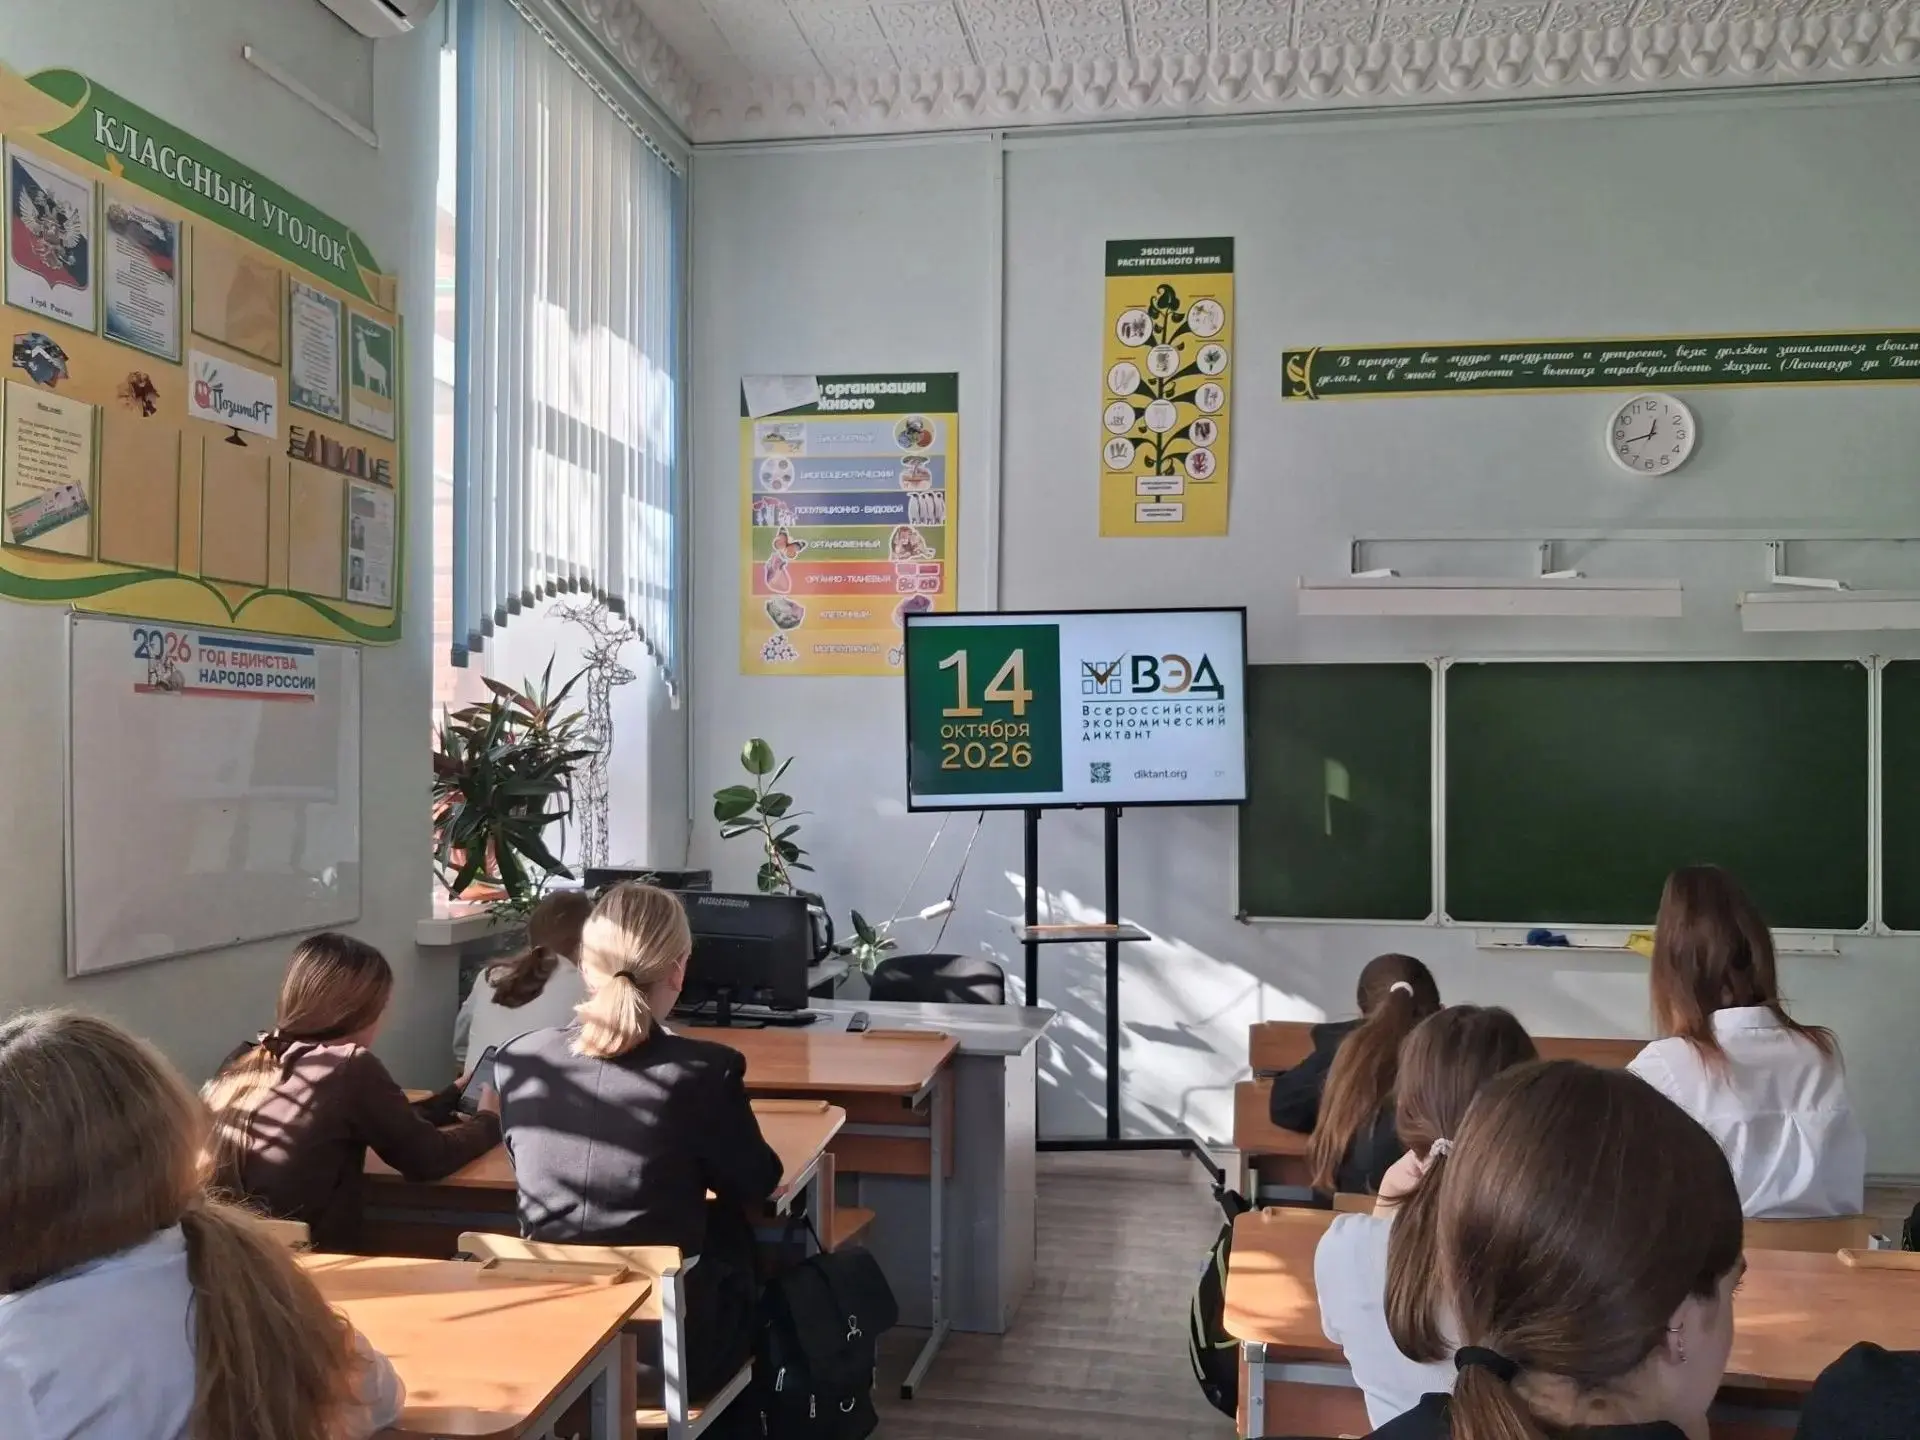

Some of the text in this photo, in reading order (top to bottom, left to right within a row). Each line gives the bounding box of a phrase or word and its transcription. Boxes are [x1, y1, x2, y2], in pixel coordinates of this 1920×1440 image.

[93, 107, 347, 271] КЛАССНЫЙ УГОЛОК
[1140, 246, 1195, 256] ЭВОЛЮЦИЯ
[1117, 255, 1221, 267] РАСТИТЕЛЬНОГО МИРА
[1338, 355, 1351, 367] В
[1357, 356, 1411, 369] природе
[1446, 353, 1492, 367] мудро
[1499, 351, 1575, 365] продумано
[1582, 352, 1592, 360] и
[1714, 343, 1769, 360] должен
[1776, 343, 1867, 359] заниматься
[1875, 339, 1919, 351] своим
[1368, 373, 1378, 381] и
[1386, 367, 1396, 381] в
[1403, 369, 1437, 381] этой
[1444, 369, 1514, 383] мудрости
[1542, 363, 1596, 378] высшая
[1603, 360, 1712, 378] справедливость
[1722, 360, 1772, 375] жизни.
[1779, 357, 1853, 373] (Леонардо
[1860, 359, 1881, 372] да
[1889, 355, 1920, 368] Вин
[825, 381, 927, 398] организации
[1632, 404, 1641, 415] 11
[1645, 400, 1657, 411] 12
[1620, 415, 1682, 426] 10 2
[1615, 430, 1686, 441] 9 3
[1620, 444, 1680, 454] 8 4
[1632, 454, 1640, 465] 7
[1644, 459, 1654, 470] 6
[864, 504, 904, 514] ВИДОВОЙ
[133, 628, 192, 664] 2026
[199, 648, 298, 670] ГОД ЕДИНСТВА
[199, 668, 316, 690] НАРОДОВ РОССИИ
[938, 648, 1033, 717] 14
[1131, 652, 1225, 701] ВЭД
[1082, 702, 1226, 718] Всероссийский
[940, 718, 1031, 741] октября
[941, 741, 1032, 769] 2026
[1133, 768, 1188, 780] diktant.org
